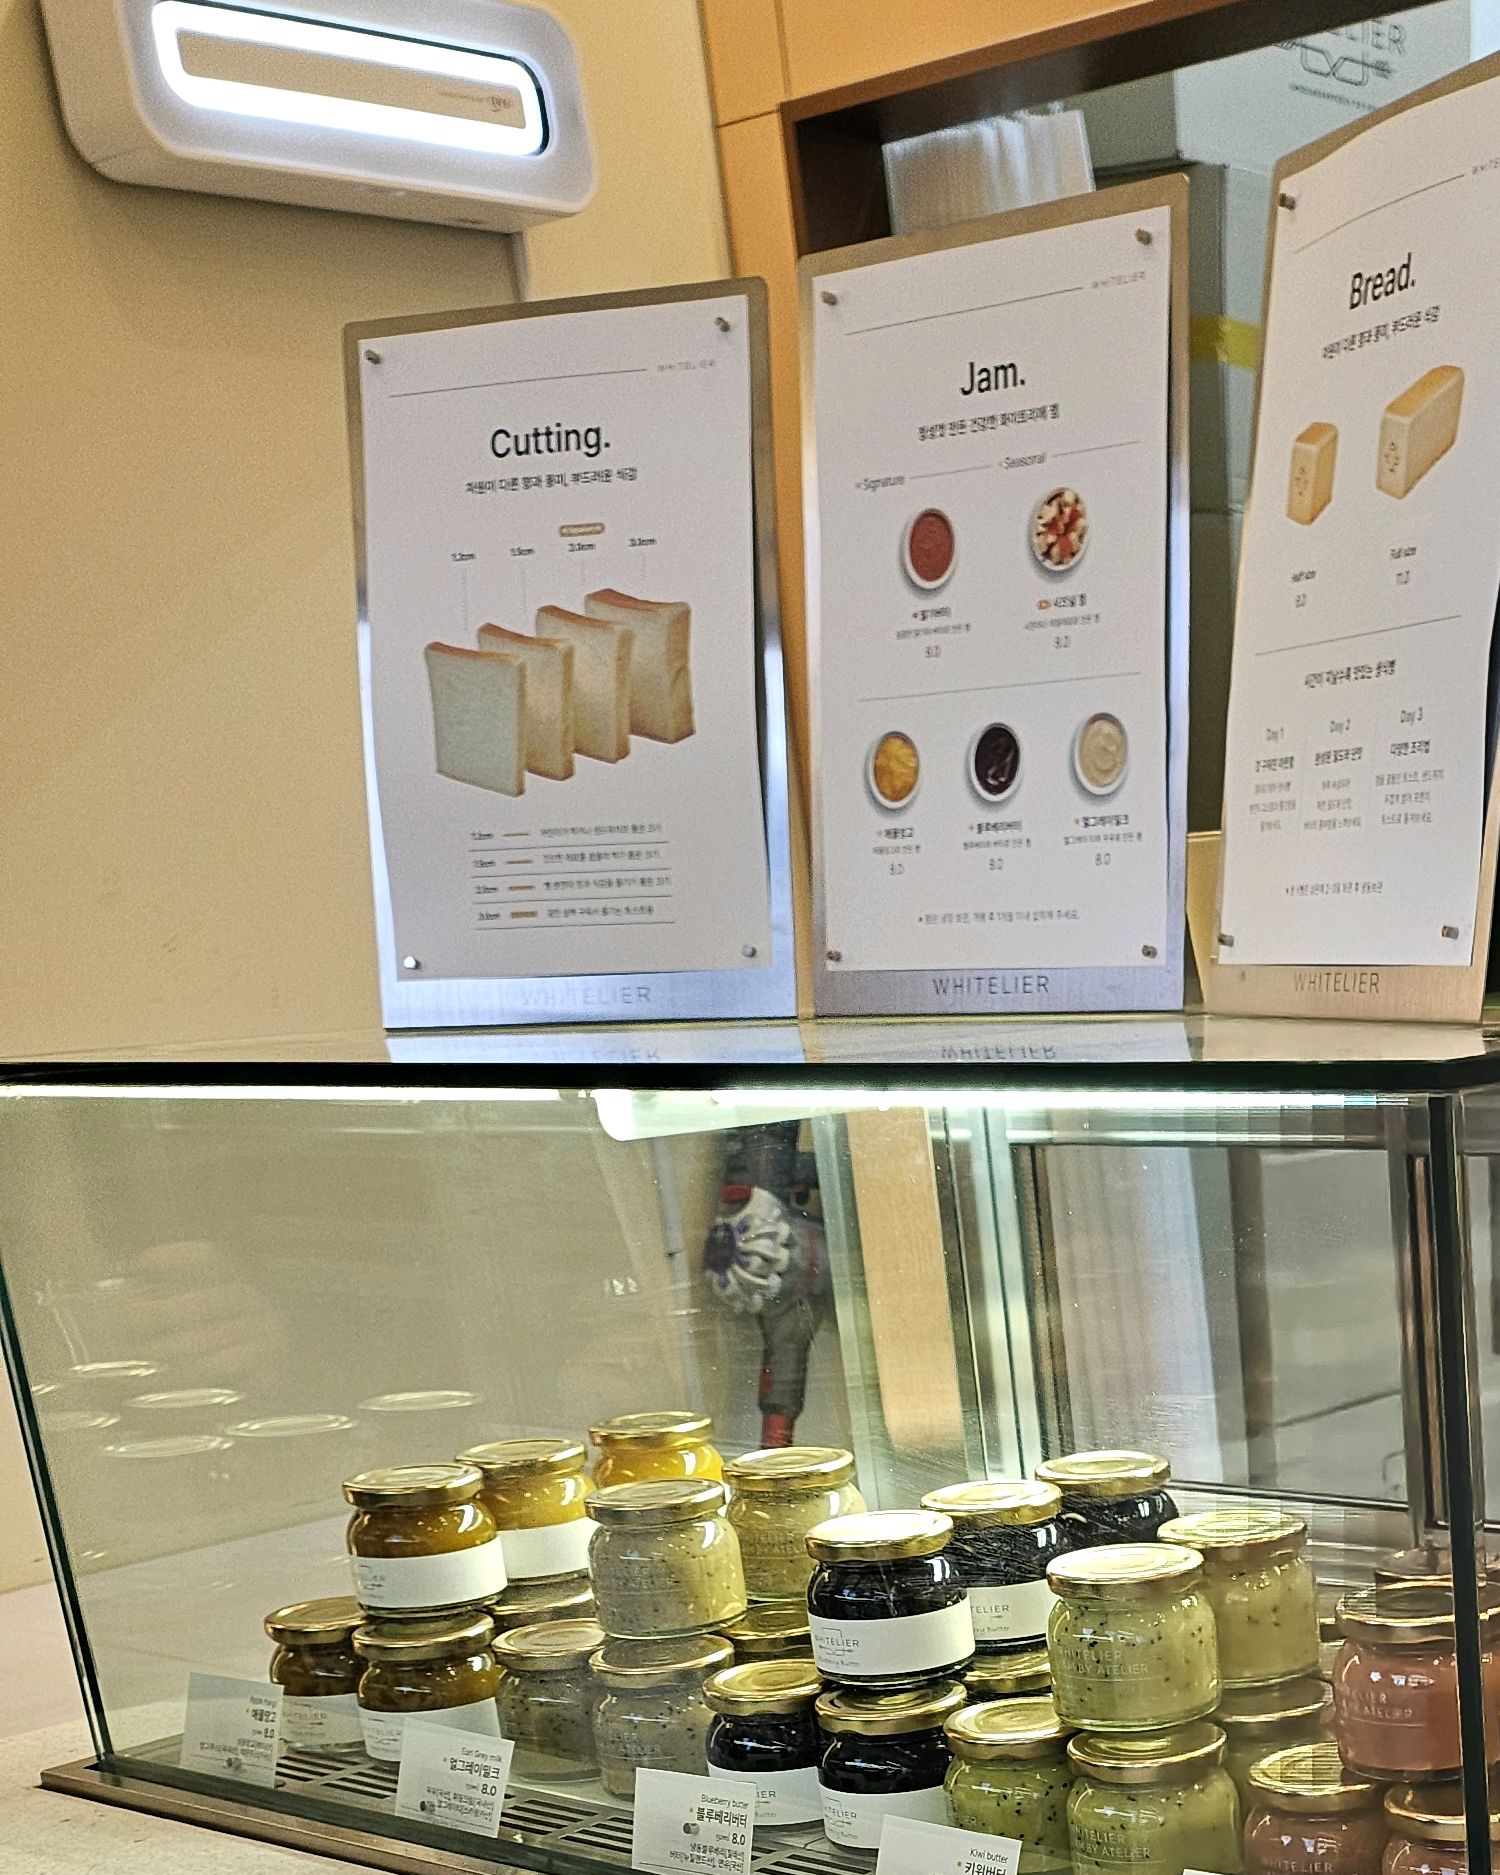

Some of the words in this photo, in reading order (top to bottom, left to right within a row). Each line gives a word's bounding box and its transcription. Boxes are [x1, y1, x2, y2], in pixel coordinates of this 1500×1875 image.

[1348, 250, 1416, 310] Bread.
[960, 360, 1026, 396] Jam.
[490, 422, 612, 458] Cutting.
[932, 974, 1050, 996] WHITELIER
[1292, 970, 1380, 996] WHITELIER
[480, 1782, 498, 1798] 8.0
[696, 1806, 748, 1830] 블루베리버터
[730, 1832, 746, 1846] 8.0
[968, 1848, 986, 1860] Kiwi
[986, 1852, 1008, 1864] butter
